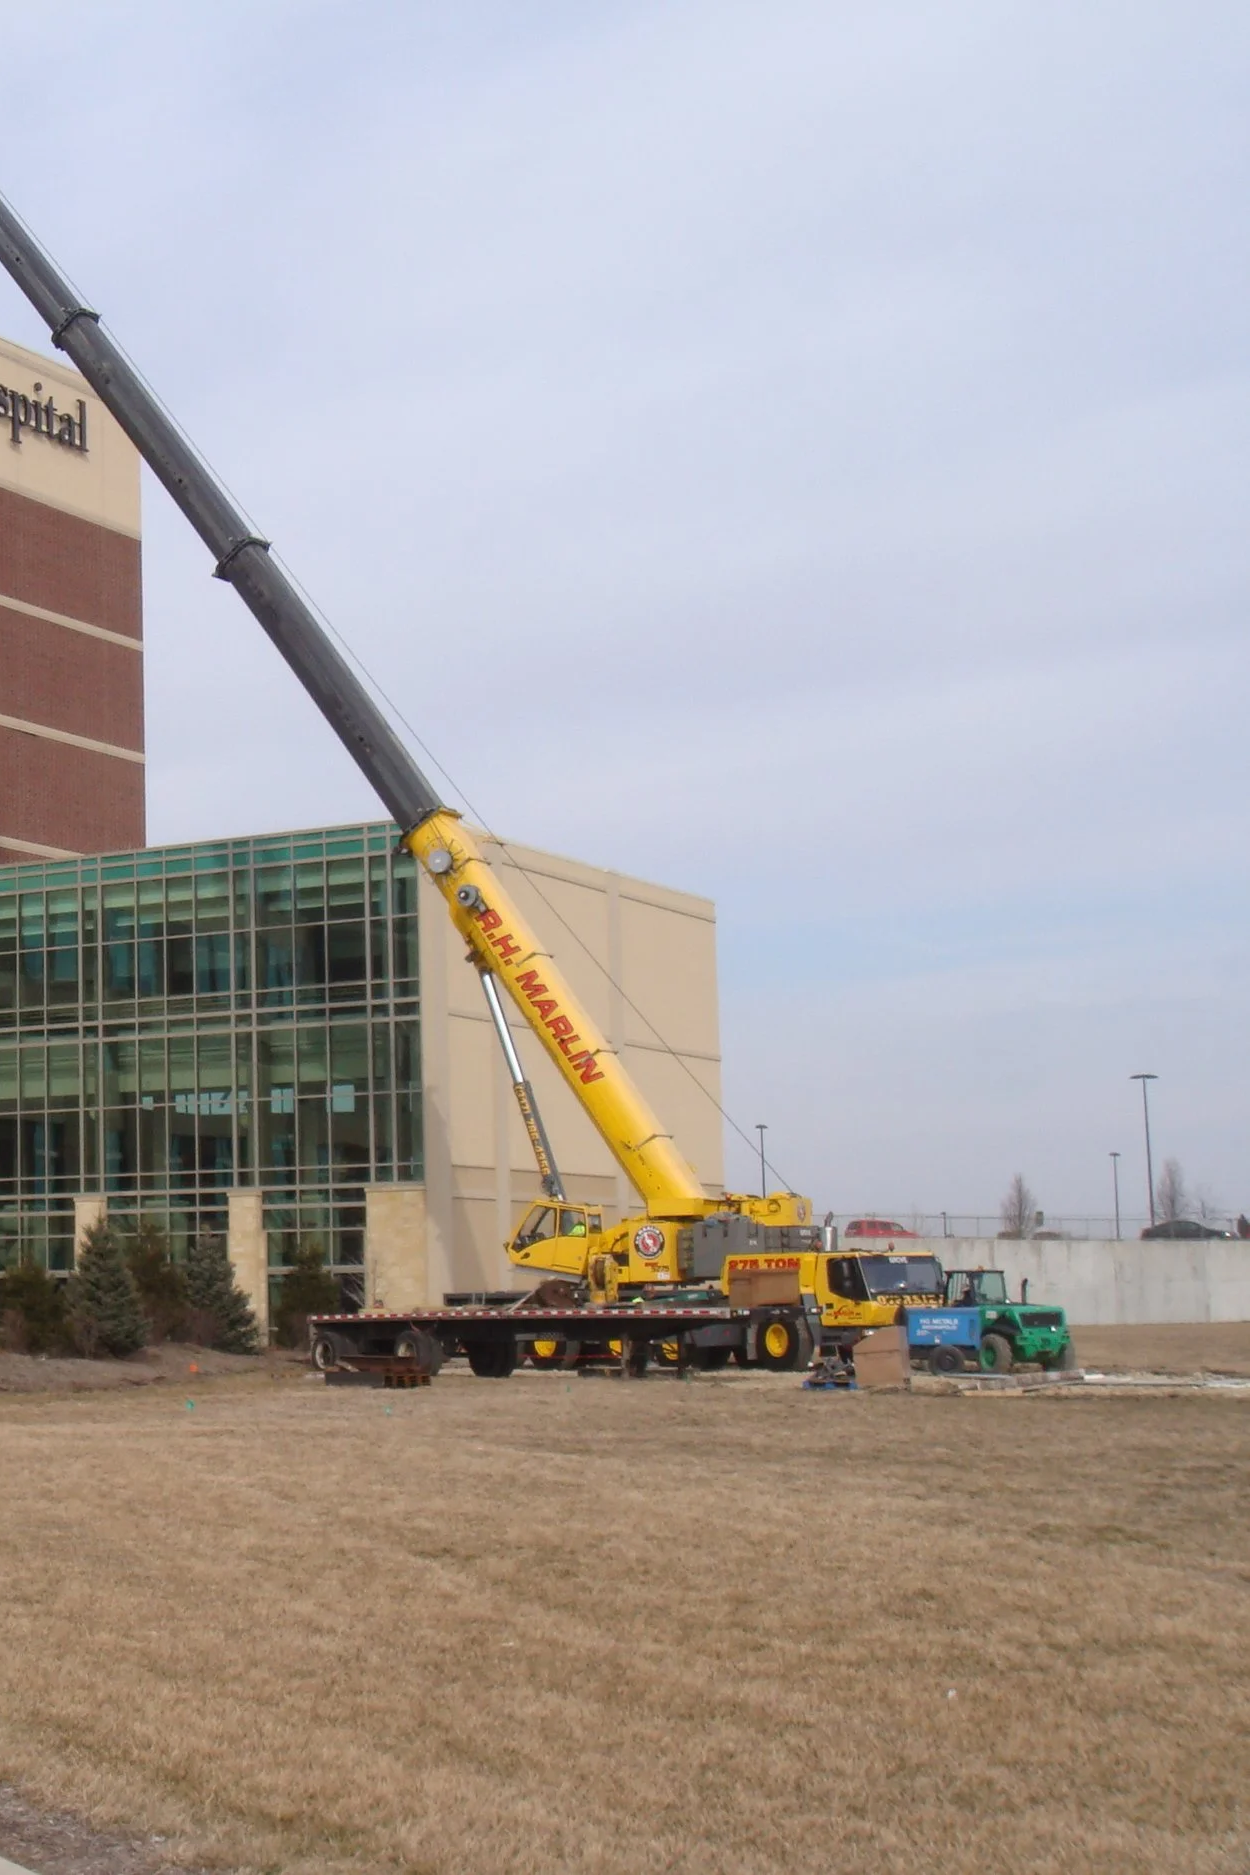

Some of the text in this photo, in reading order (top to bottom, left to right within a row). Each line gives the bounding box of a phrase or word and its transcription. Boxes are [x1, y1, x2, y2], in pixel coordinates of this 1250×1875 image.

[473, 908, 605, 1085] R.H. MARLIN
[764, 1258, 800, 1270] TON
